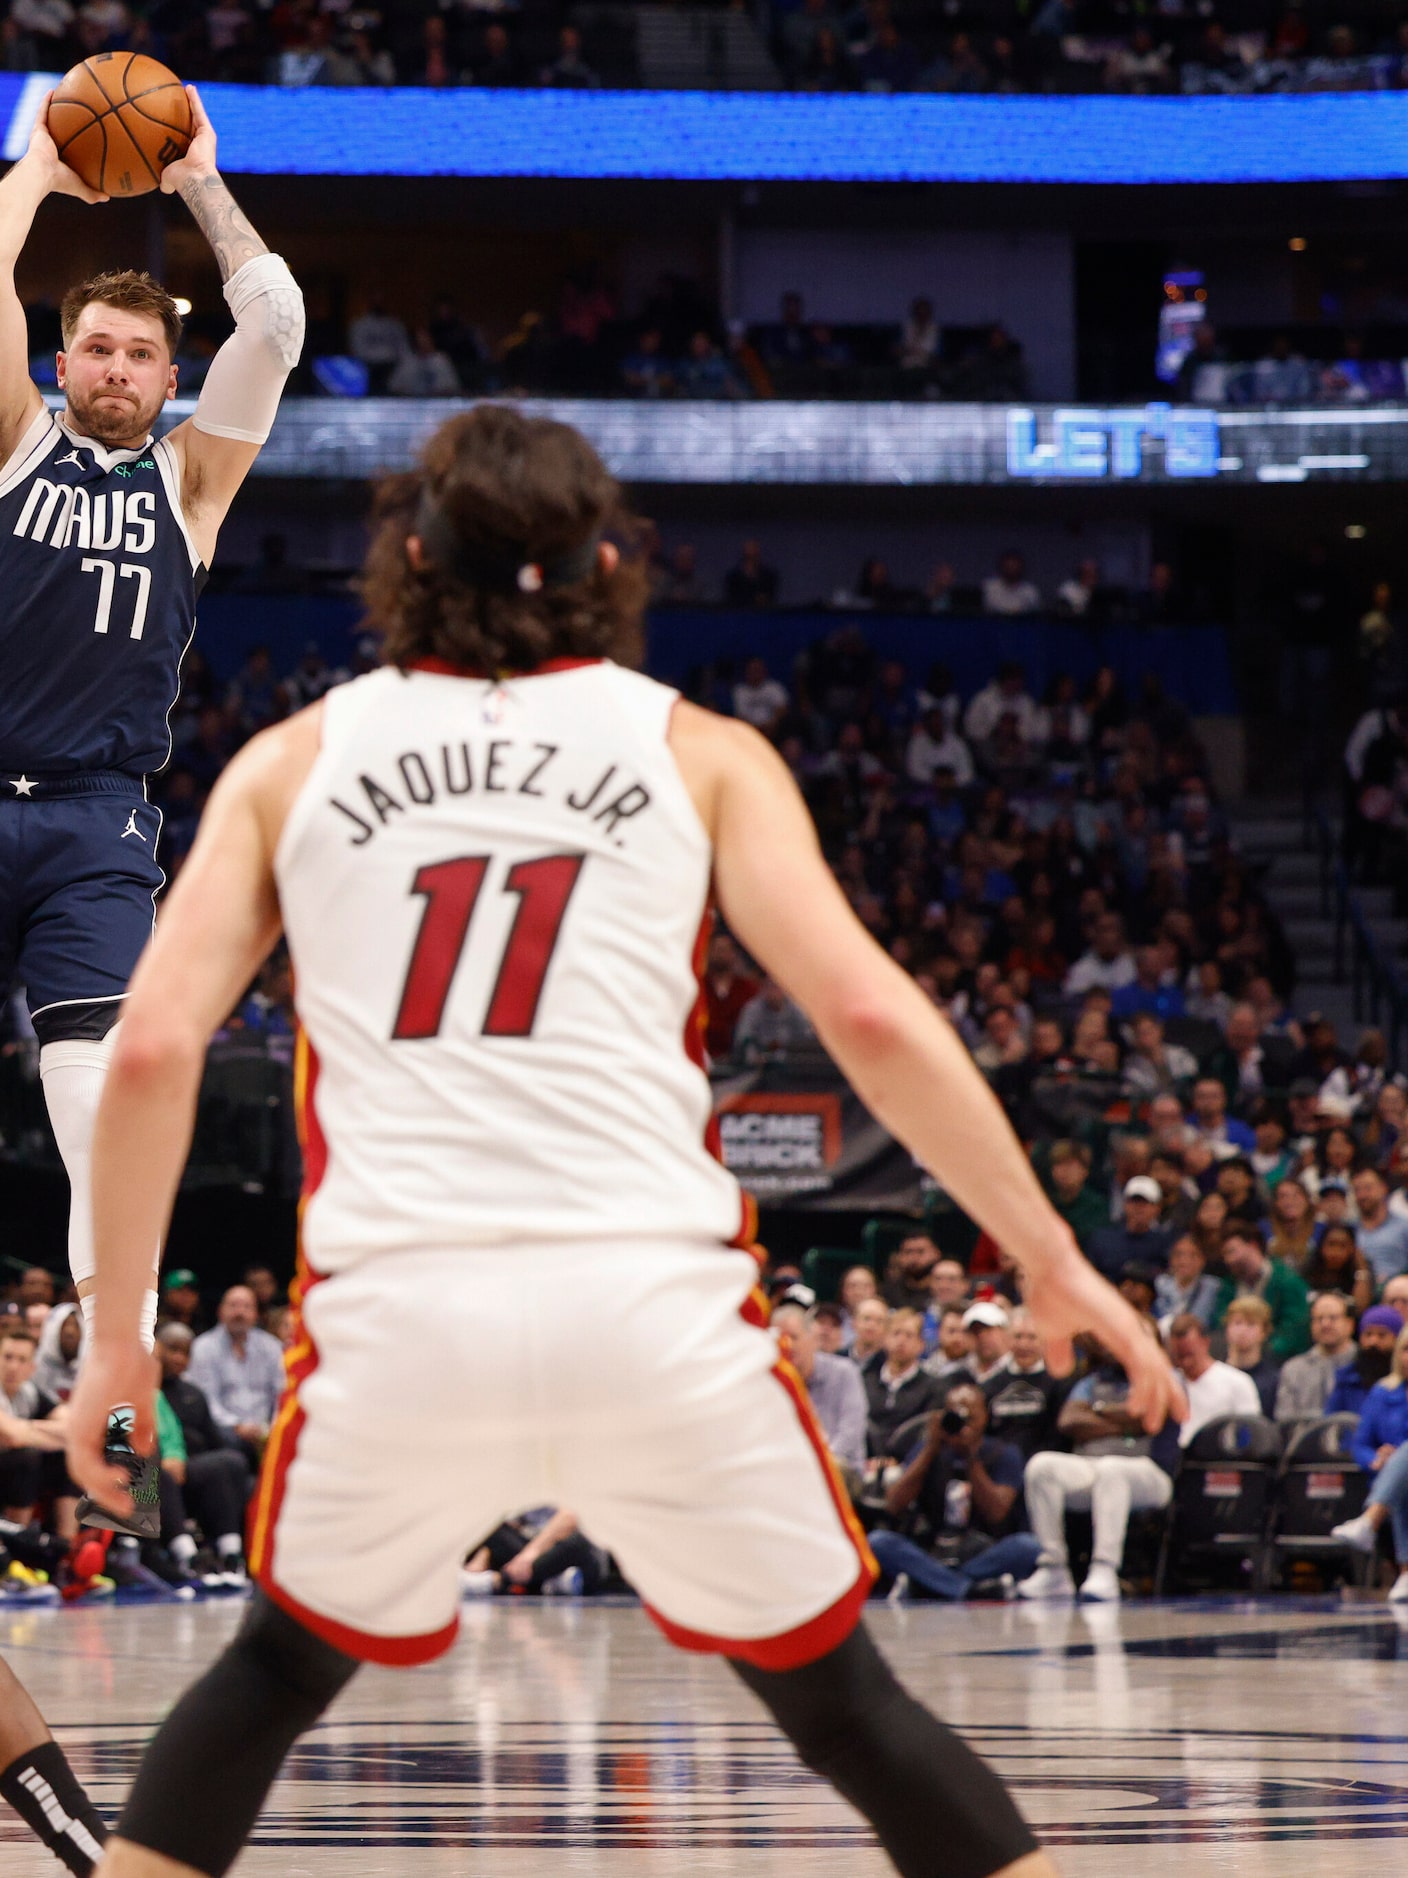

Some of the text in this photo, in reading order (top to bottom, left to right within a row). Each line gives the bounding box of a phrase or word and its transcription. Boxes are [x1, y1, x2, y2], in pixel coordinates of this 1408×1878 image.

[1006, 402, 1220, 478] LET'S
[12, 477, 156, 554] MAVS
[80, 557, 152, 641] 77
[329, 739, 653, 848] JAQUEZ JR.
[389, 854, 588, 1041] 11
